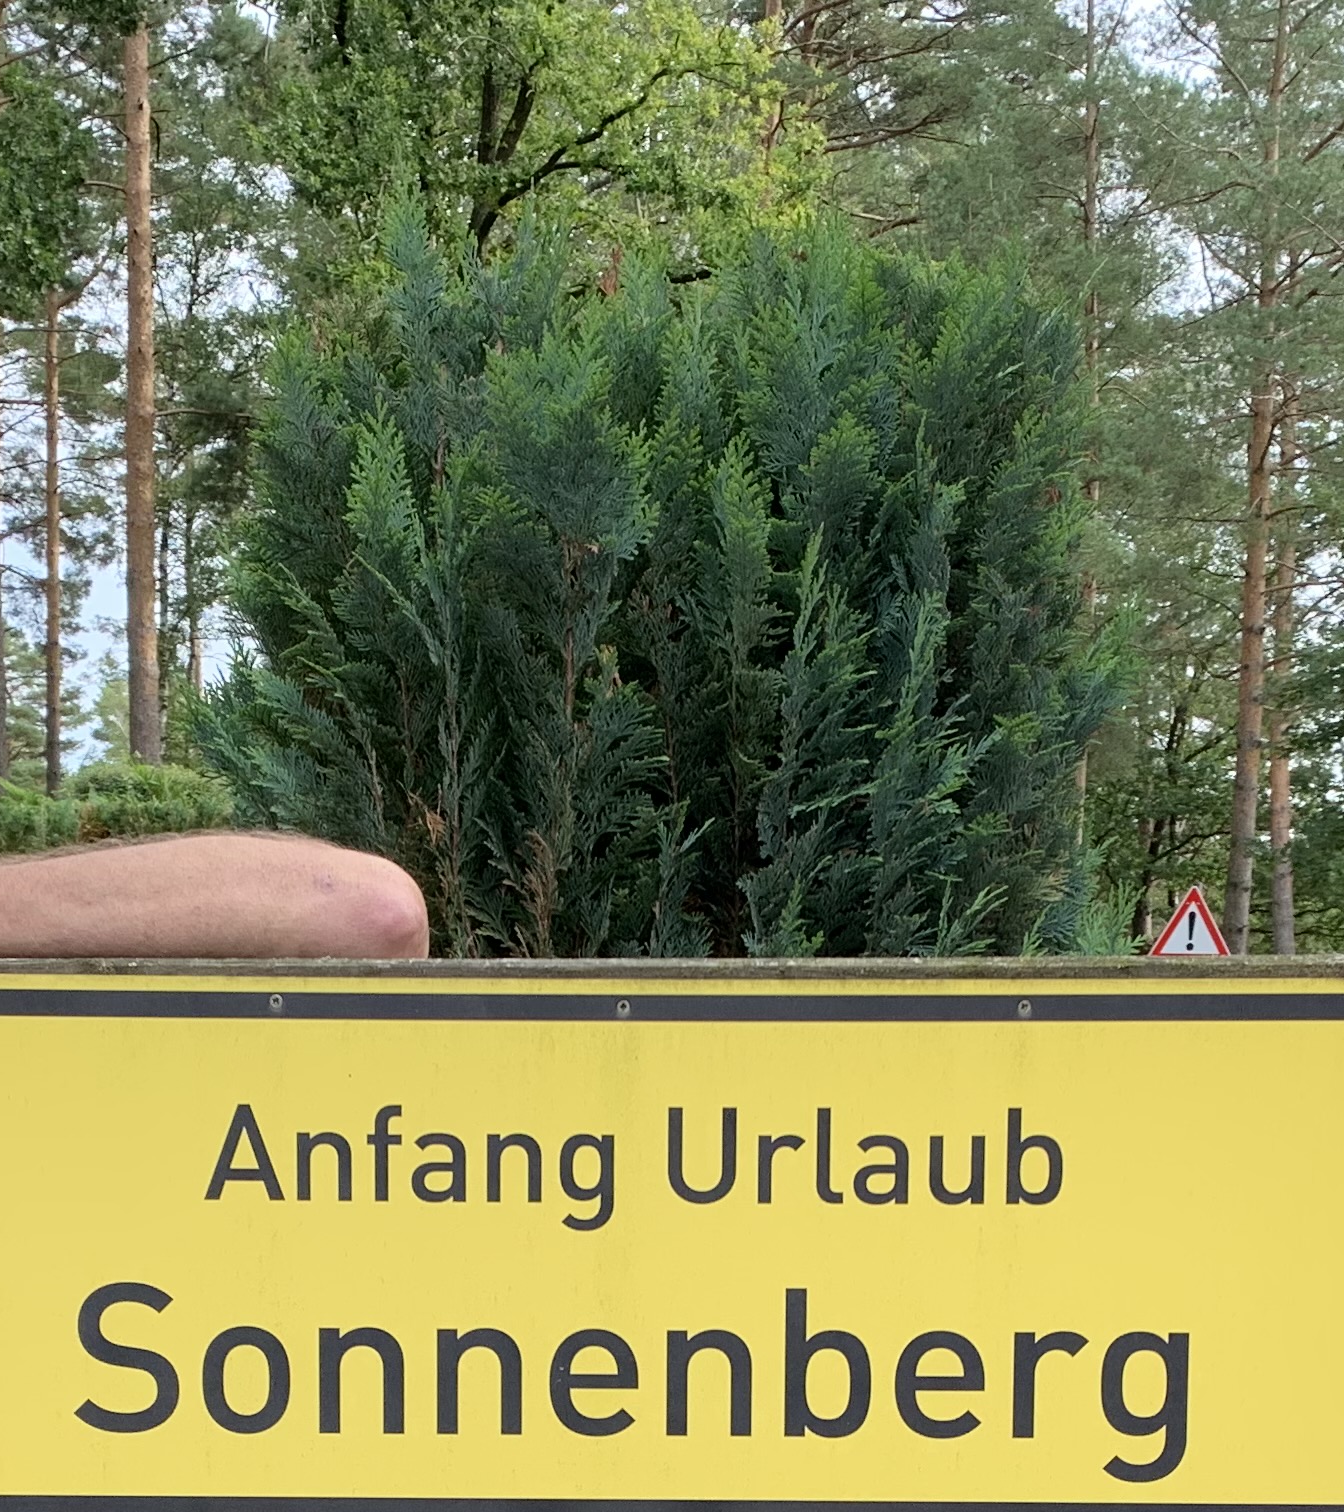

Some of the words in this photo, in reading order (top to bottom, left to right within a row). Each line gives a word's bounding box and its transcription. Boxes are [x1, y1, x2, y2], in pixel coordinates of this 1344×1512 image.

[205, 1104, 615, 1231] Anfang
[667, 1106, 1063, 1205] Urlaub
[74, 1282, 1190, 1483] Sonnenberg
